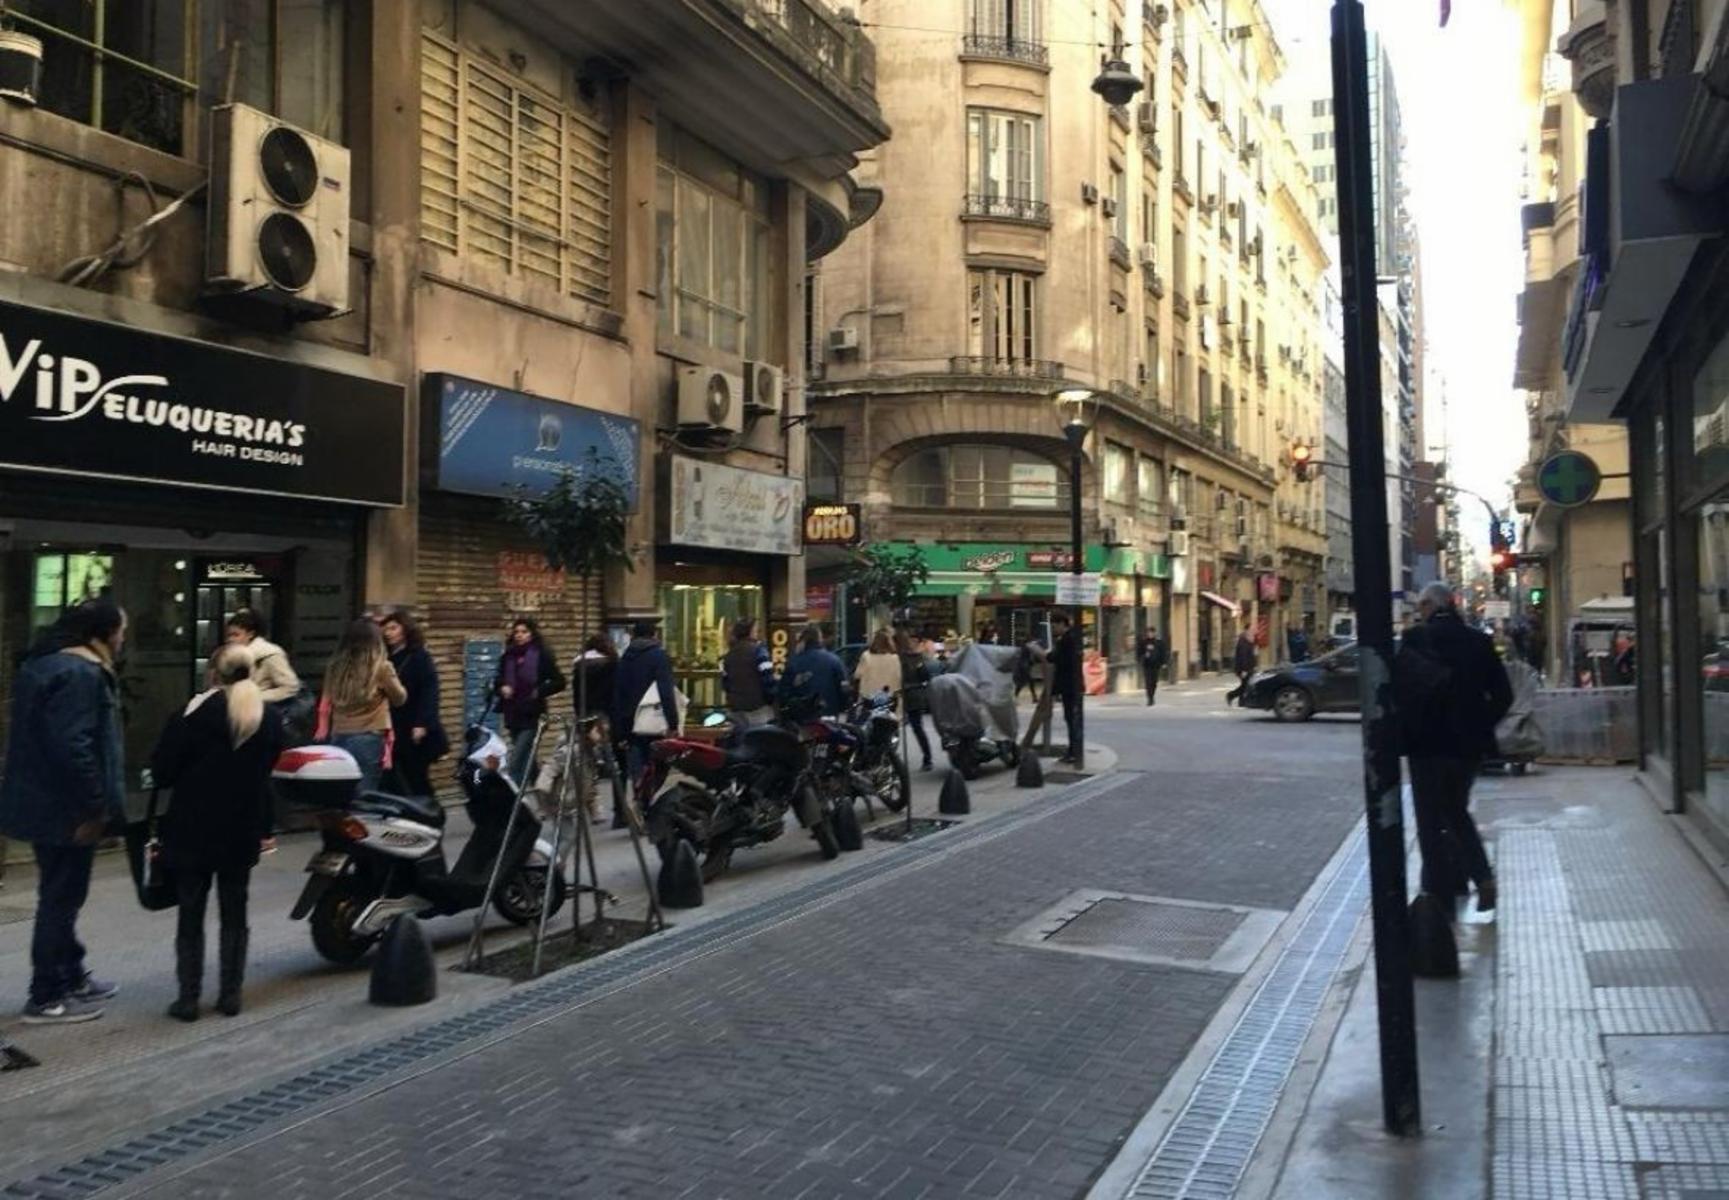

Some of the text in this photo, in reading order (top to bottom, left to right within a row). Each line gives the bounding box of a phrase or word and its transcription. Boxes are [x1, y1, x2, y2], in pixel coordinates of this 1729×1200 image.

[192, 439, 304, 466] HAIR DESIGN
[807, 514, 855, 540] ORO
